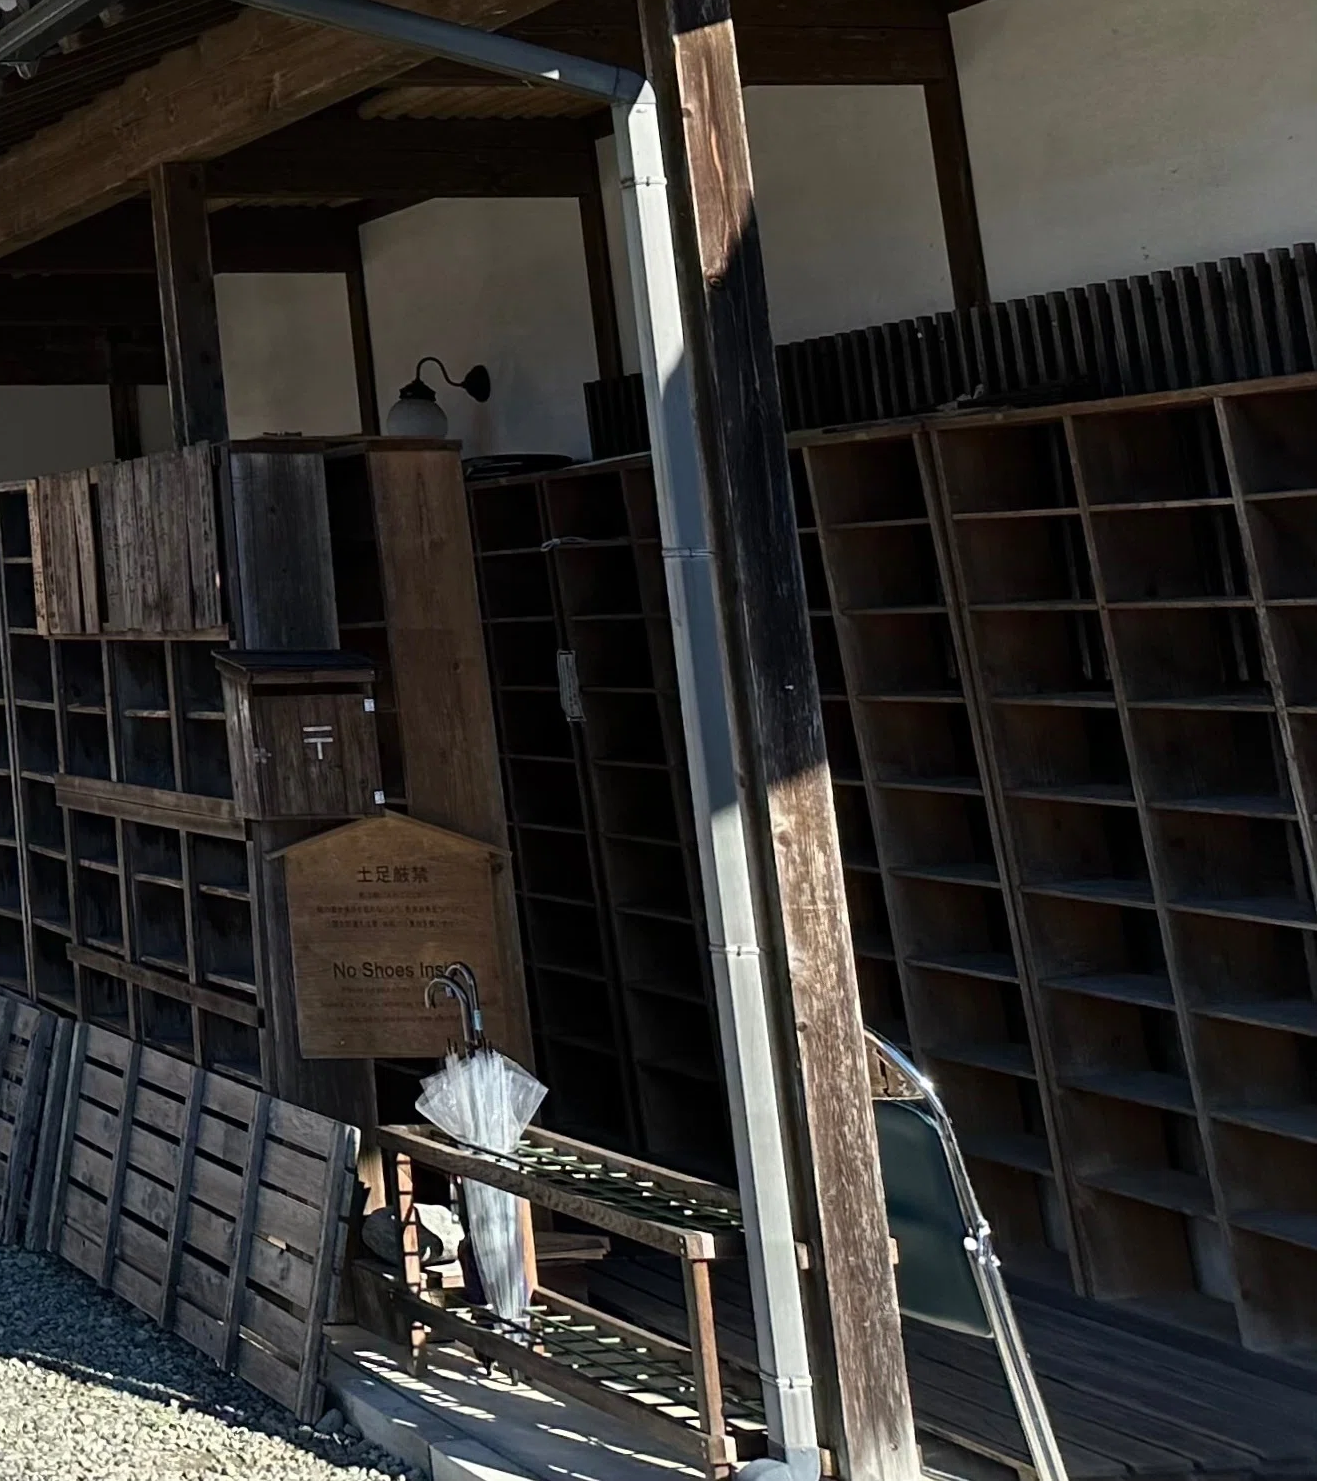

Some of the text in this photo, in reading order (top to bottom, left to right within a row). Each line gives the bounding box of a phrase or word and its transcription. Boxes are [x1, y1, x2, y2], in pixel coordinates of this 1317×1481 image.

[358, 866, 428, 883] 土足厳禁
[334, 962, 357, 979] No
[362, 961, 414, 978] Shoes
